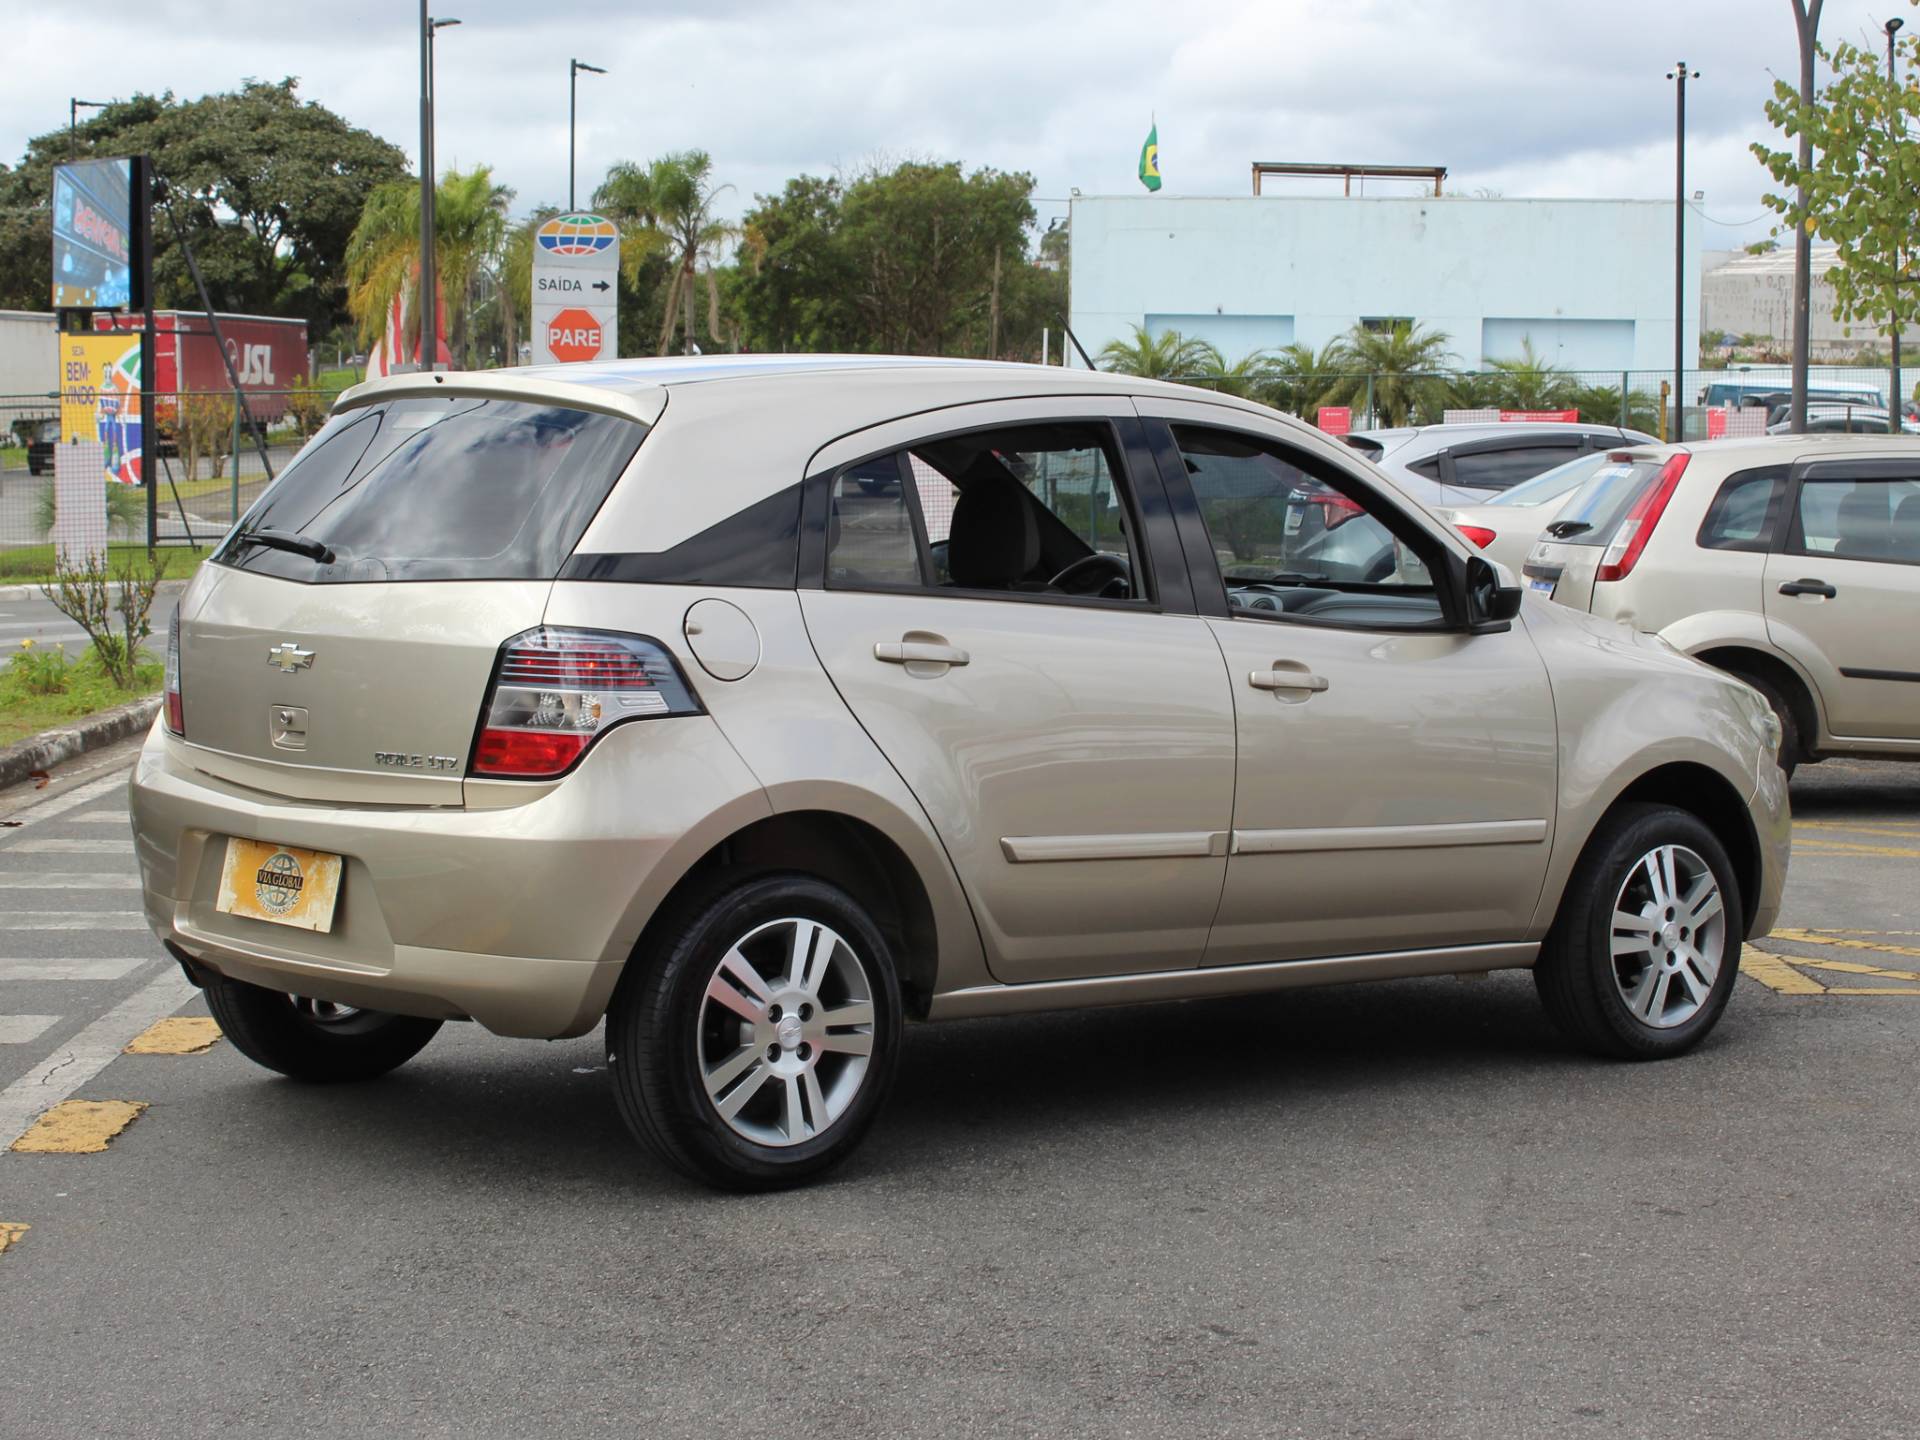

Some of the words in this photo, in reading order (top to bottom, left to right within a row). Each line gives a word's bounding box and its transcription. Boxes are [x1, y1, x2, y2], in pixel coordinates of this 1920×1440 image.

[538, 275, 582, 291] SAÍDA
[549, 328, 601, 347] PARE
[239, 343, 275, 385] JSL
[64, 385, 96, 405] VINDO
[428, 755, 458, 771] LTZ
[258, 870, 271, 884] VIA
[272, 873, 302, 890] GLOBAL
